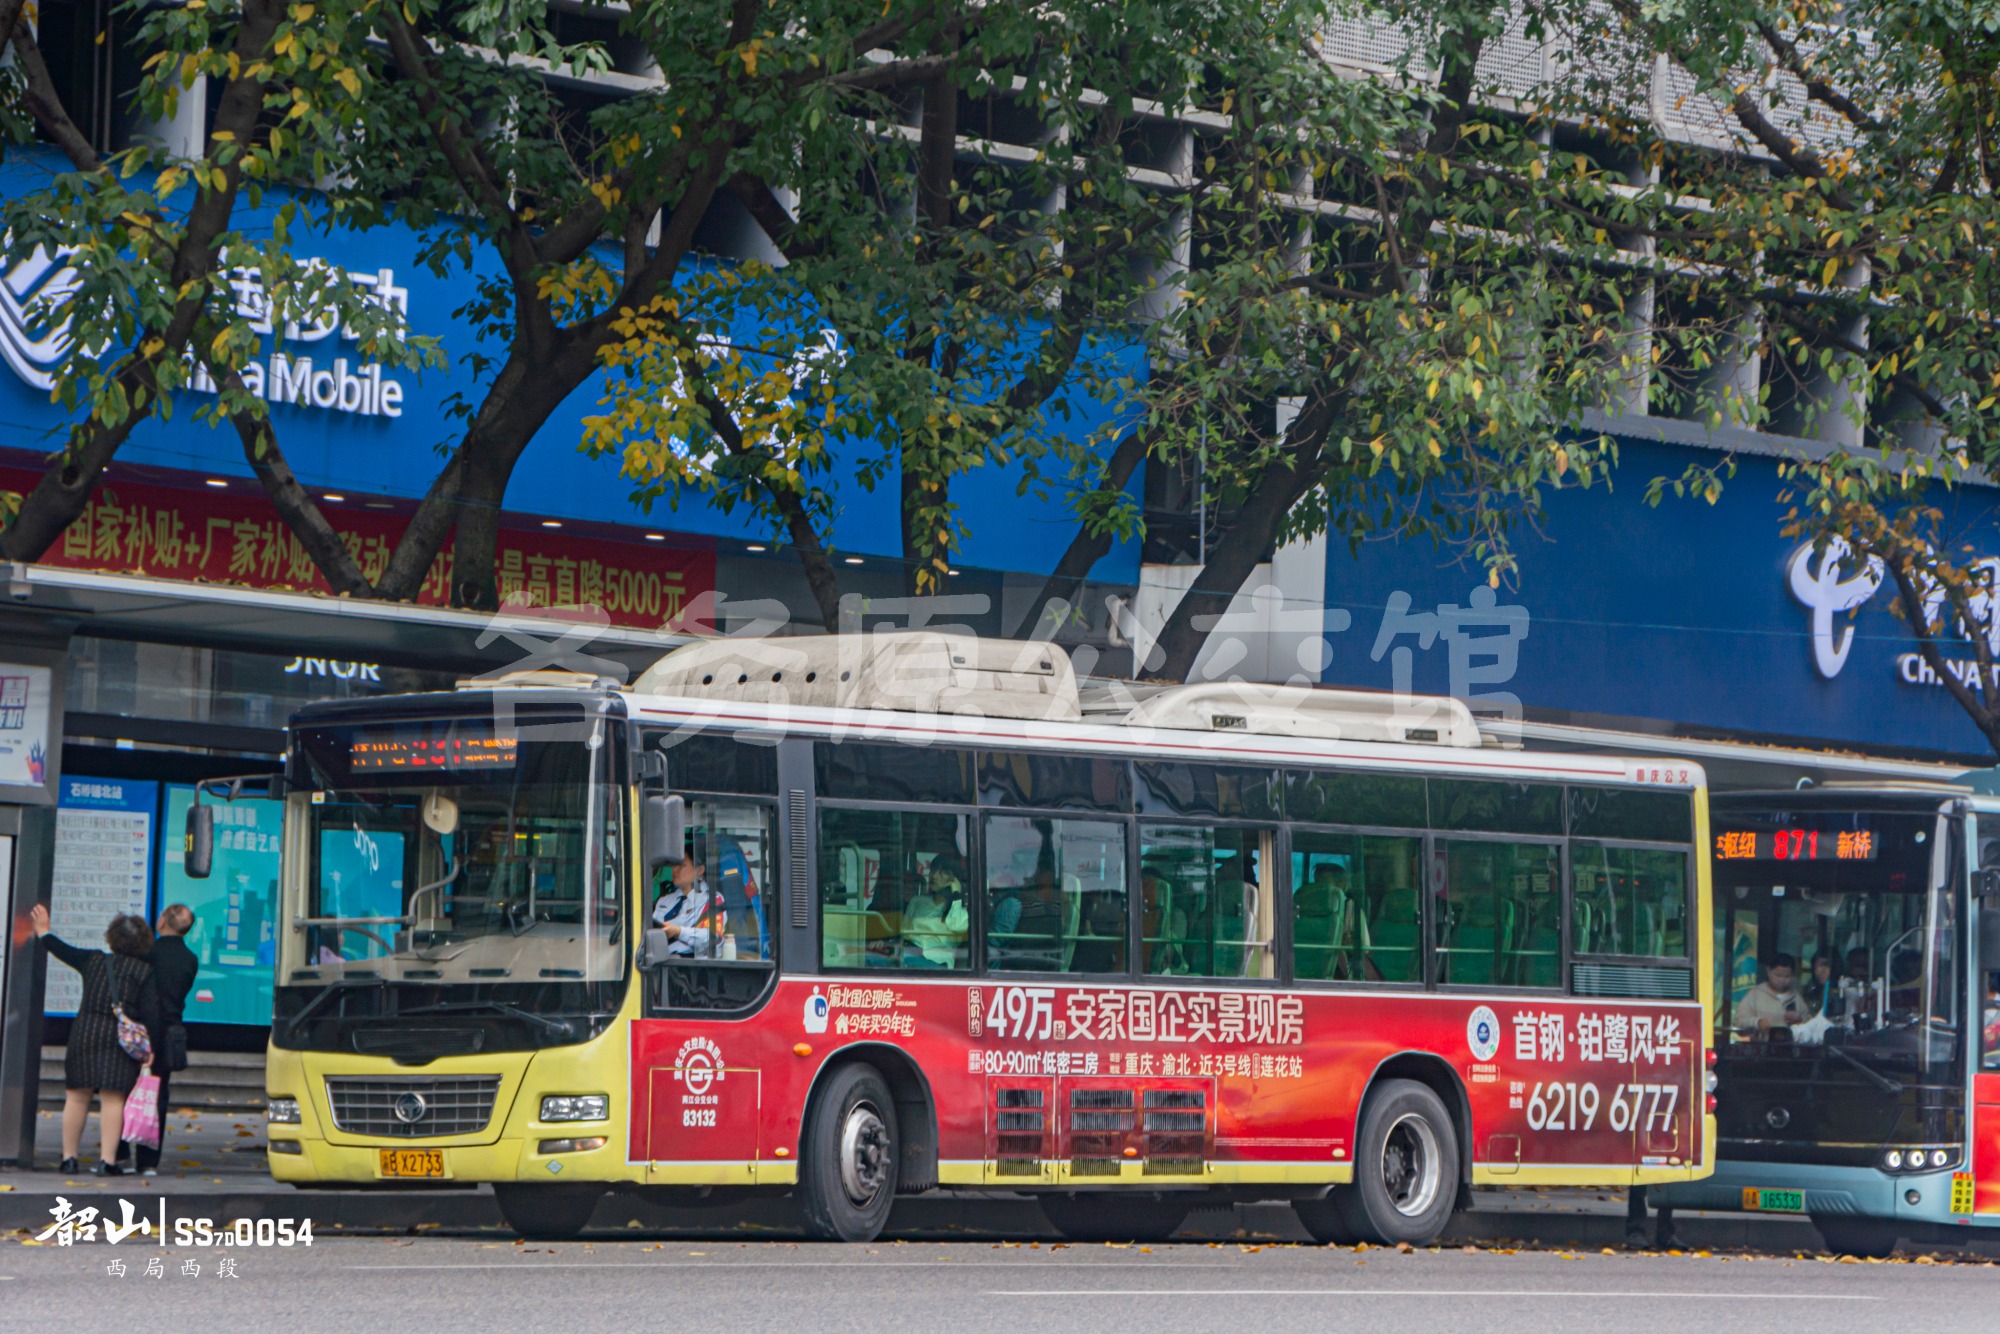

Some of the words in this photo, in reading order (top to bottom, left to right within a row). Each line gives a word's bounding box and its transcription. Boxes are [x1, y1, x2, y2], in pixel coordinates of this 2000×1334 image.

[268, 353, 403, 417] Mobile
[1774, 830, 1818, 860] 871
[1836, 831, 1871, 859] 新桥
[830, 986, 896, 1010] 渝北国企现房
[970, 990, 980, 1034] 总价约
[849, 1011, 914, 1035] 今年买今年住
[986, 987, 1054, 1041] 49万
[1066, 989, 1304, 1044] 安家国企实景现房
[1260, 1055, 1303, 1078] 莲花站
[683, 1109, 716, 1127] 83132
[1526, 1082, 1599, 1131] 6219
[1609, 1084, 1678, 1132] 6777
